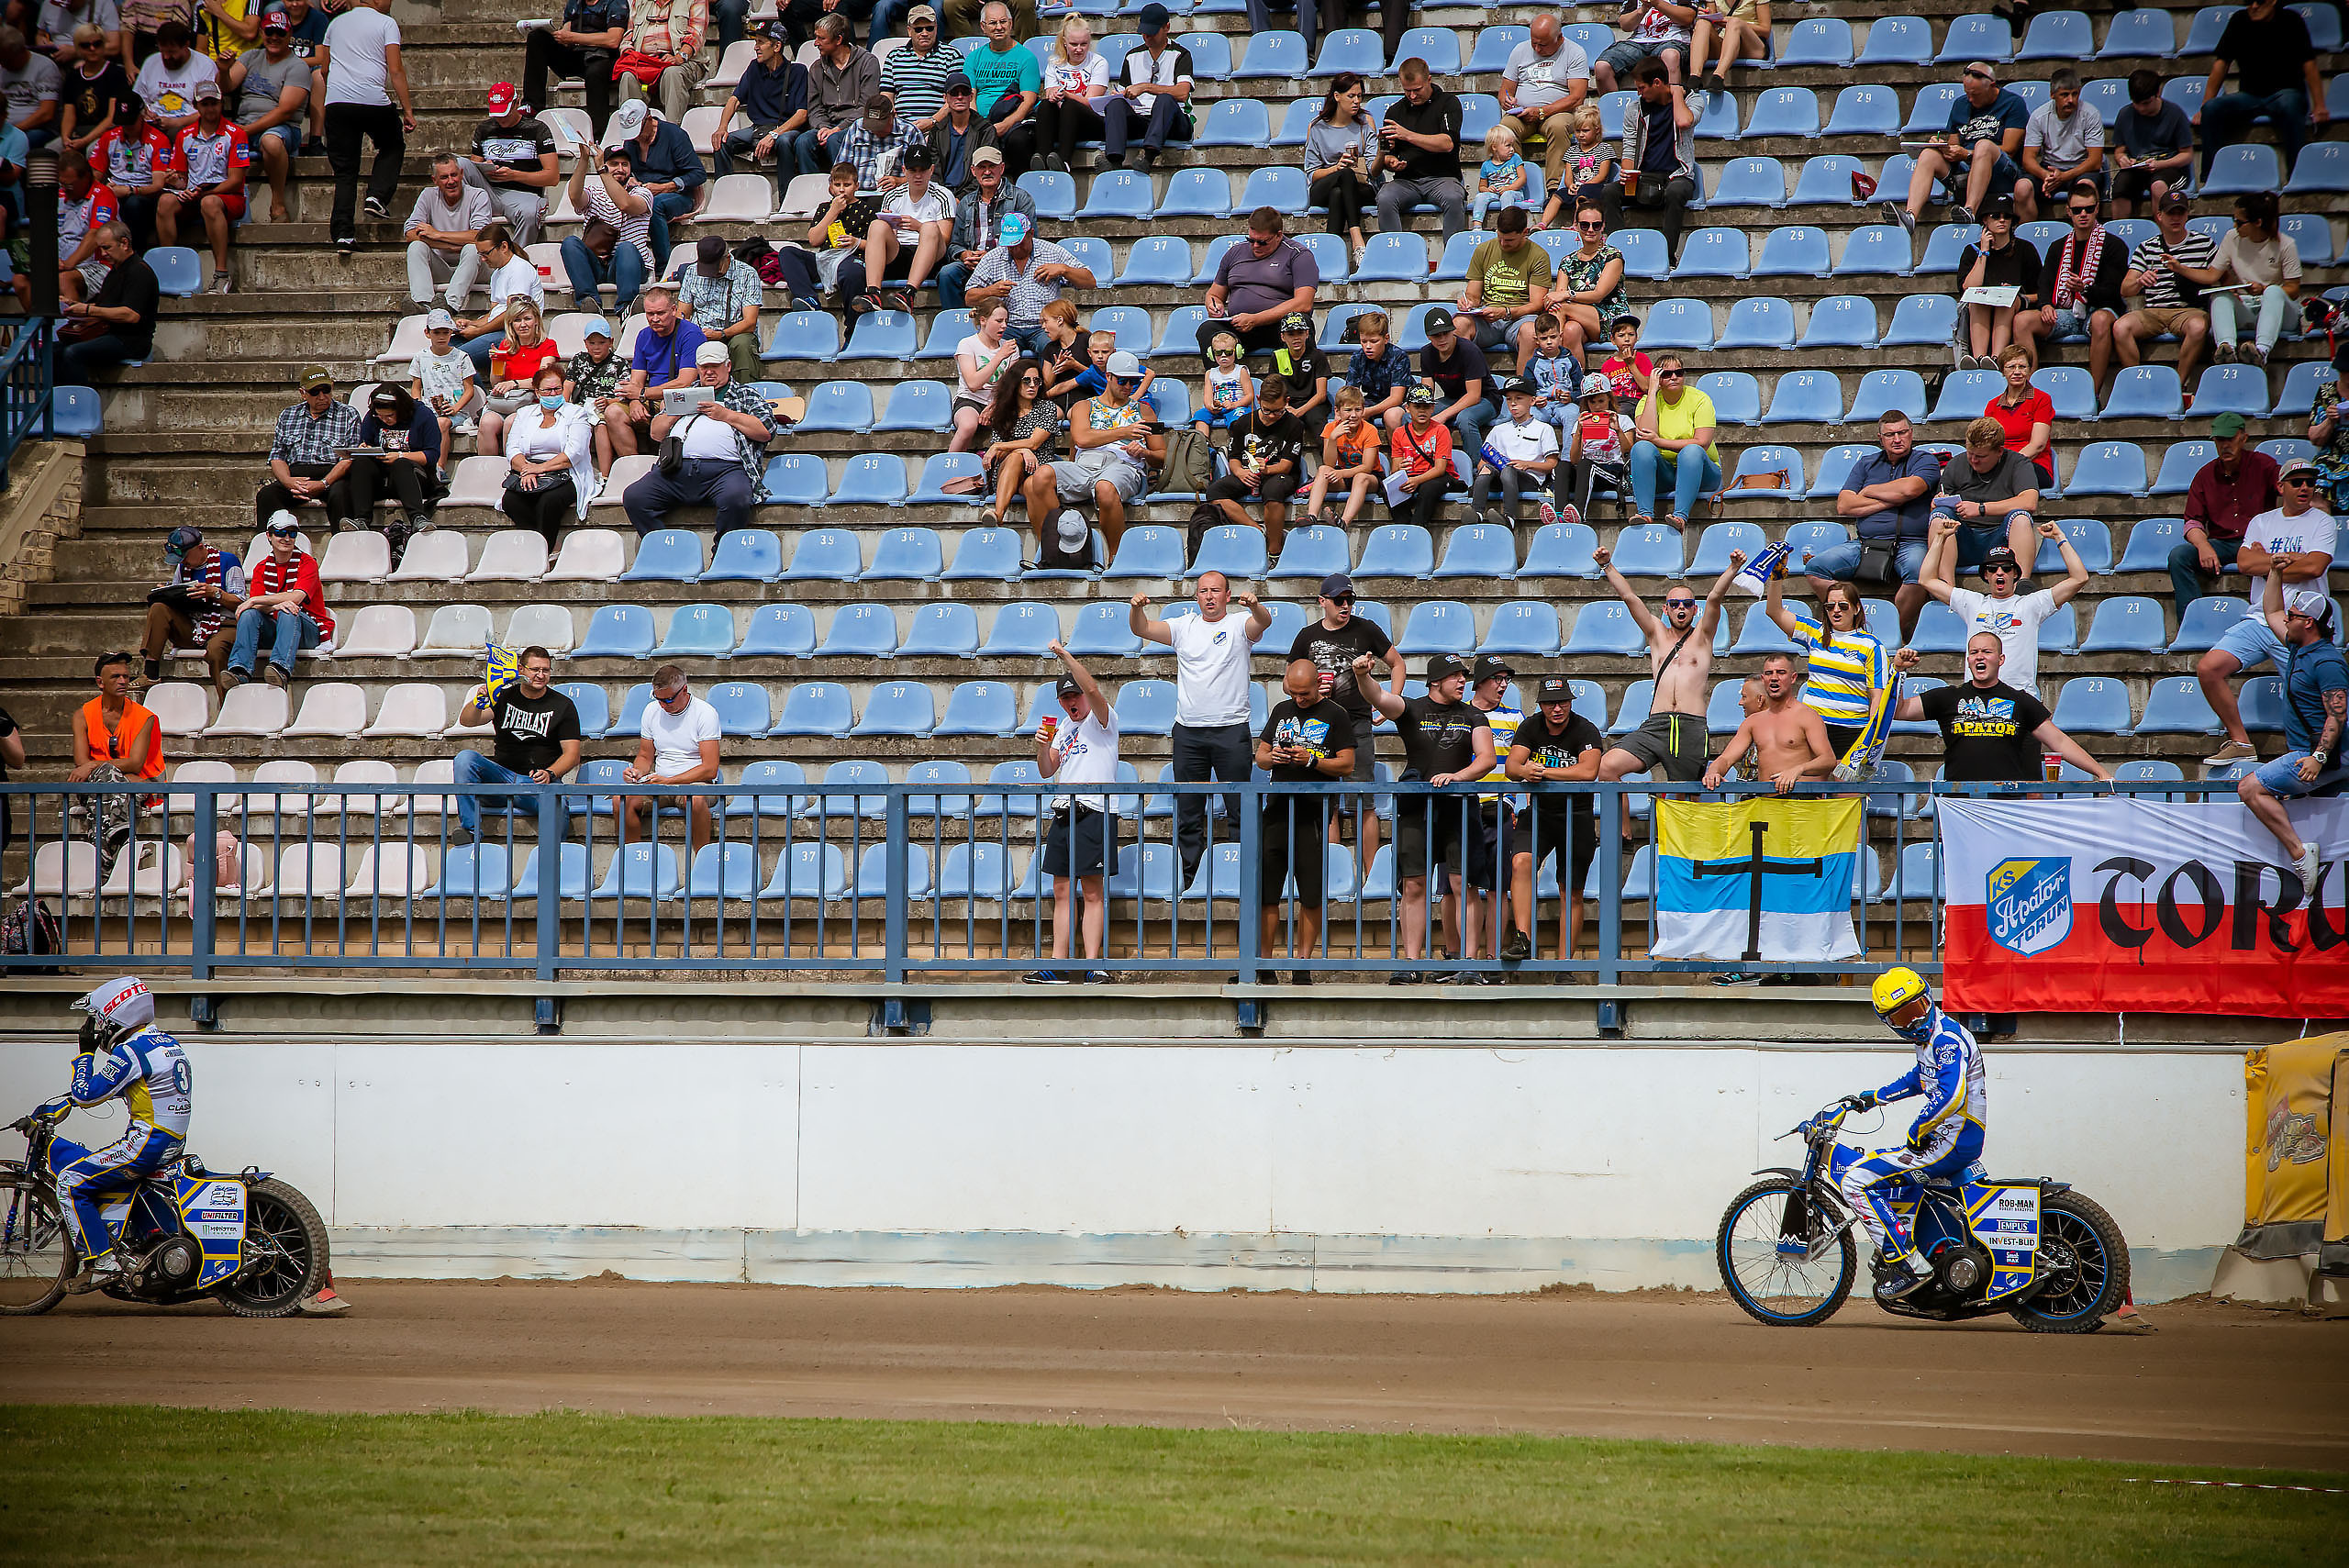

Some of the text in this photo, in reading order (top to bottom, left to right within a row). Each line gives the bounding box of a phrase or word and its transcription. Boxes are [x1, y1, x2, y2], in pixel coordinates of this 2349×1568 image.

[1813, 24, 1826, 35] 30
[1891, 21, 1907, 34] 29
[1345, 34, 1359, 45] 36
[1421, 35, 1434, 45] 35
[1577, 29, 1589, 40] 33
[1118, 39, 1134, 50] 39
[1196, 37, 1208, 48] 38
[1269, 38, 1282, 49] 37
[992, 70, 1018, 79] WOOD
[2102, 83, 2116, 95] 26
[2186, 82, 2201, 94] 25
[1778, 93, 1794, 104] 30
[1856, 92, 1872, 103] 29
[1940, 88, 1954, 100] 28
[1229, 103, 1242, 115] 37
[1309, 101, 1323, 113] 36
[1463, 100, 1476, 111] 34
[1749, 162, 1763, 173] 30
[1823, 159, 1837, 171] 29
[1039, 175, 1054, 186] 39
[1117, 175, 1130, 185] 38
[1194, 173, 1206, 184] 37
[1265, 172, 1278, 183] 36
[1790, 229, 1805, 241] 29
[1953, 228, 1968, 239] 27
[2033, 227, 2049, 238] 26
[2118, 224, 2133, 236] 25
[1387, 237, 1400, 248] 34
[1468, 234, 1482, 246] 33
[1547, 236, 1561, 247] 32
[1627, 234, 1640, 245] 31
[1706, 233, 1722, 244] 30
[1868, 231, 1883, 243] 28
[1073, 241, 1088, 252] 38
[1153, 240, 1168, 251] 37
[1304, 238, 1318, 250] 35
[1490, 275, 1527, 288] ORIGINAL
[1753, 302, 1769, 313] 29
[1835, 300, 1851, 311] 28
[1918, 298, 1934, 309] 27
[1670, 304, 1685, 315] 30
[954, 313, 970, 324] 39
[1111, 311, 1125, 322] 37
[1190, 310, 1203, 321] 36
[796, 316, 808, 327] 41
[877, 316, 891, 327] 40
[1301, 359, 1313, 373] 5
[1881, 373, 1899, 385] 27
[1966, 373, 1983, 384] 26
[2136, 368, 2152, 380] 24
[2222, 368, 2238, 380] 23
[1717, 376, 1733, 387] 29
[1798, 375, 1814, 386] 28
[831, 385, 845, 396] 40
[913, 385, 928, 396] 39
[1152, 381, 1167, 393] 36
[69, 395, 75, 405] 6
[1761, 449, 1781, 462] 28
[2103, 445, 2119, 459] 24
[2188, 445, 2204, 457] 23
[863, 458, 879, 470] 39
[944, 458, 959, 469] 38
[1223, 528, 1238, 539] 34
[1308, 529, 1323, 540] 33
[1473, 528, 1485, 540] 31
[1554, 528, 1572, 539] 30
[1728, 526, 1742, 538] 28
[1811, 526, 1826, 538] 27
[2072, 526, 2087, 537] 24
[2156, 523, 2172, 535] 23
[664, 535, 674, 546] 41
[820, 535, 835, 545] 39
[901, 531, 915, 542] 38
[982, 532, 996, 544] 37
[1144, 529, 1157, 541] 35
[1389, 529, 1408, 541] 32
[1644, 530, 1662, 543] 29
[740, 535, 755, 547] 40
[855, 606, 872, 618] 38
[936, 606, 952, 618] 37
[1019, 606, 1033, 617] 36
[1099, 606, 1114, 618] 35
[1432, 606, 1446, 617] 31
[1516, 606, 1531, 617] 30
[1607, 606, 1622, 618] 29
[1862, 604, 1876, 615] 26
[2127, 602, 2140, 614] 23
[2213, 601, 2229, 613] 22
[614, 609, 626, 621] 41
[693, 608, 707, 620] 40
[774, 609, 789, 621] 39
[729, 686, 744, 697] 39
[975, 685, 987, 696] 36
[1139, 686, 1152, 698] 34
[2087, 681, 2103, 692] 23
[2179, 682, 2194, 694] 22
[2269, 683, 2284, 695] 21
[567, 686, 581, 699] 41
[809, 687, 824, 698] 38
[892, 687, 906, 698] 37
[501, 703, 554, 738] EVERLAST
[1953, 721, 2017, 736] APATOR
[598, 765, 613, 777] 40
[763, 765, 777, 776] 38
[849, 765, 863, 777] 37
[926, 767, 939, 779] 36
[1013, 766, 1027, 778] 35
[2140, 766, 2154, 778] 22
[2230, 767, 2243, 779] 21
[635, 850, 650, 862] 39
[801, 851, 816, 862] 37
[1224, 850, 1239, 862] 32
[1992, 870, 2016, 897] KS
[1995, 864, 2067, 938] Apator
[176, 1062, 189, 1094] 3
[1998, 1198, 2034, 1208] ROB-MAN
[202, 1211, 238, 1220] UNIFILTER
[1996, 1218, 2030, 1232] TEMPUS
[1988, 1237, 2035, 1247] INVEST-BUD
